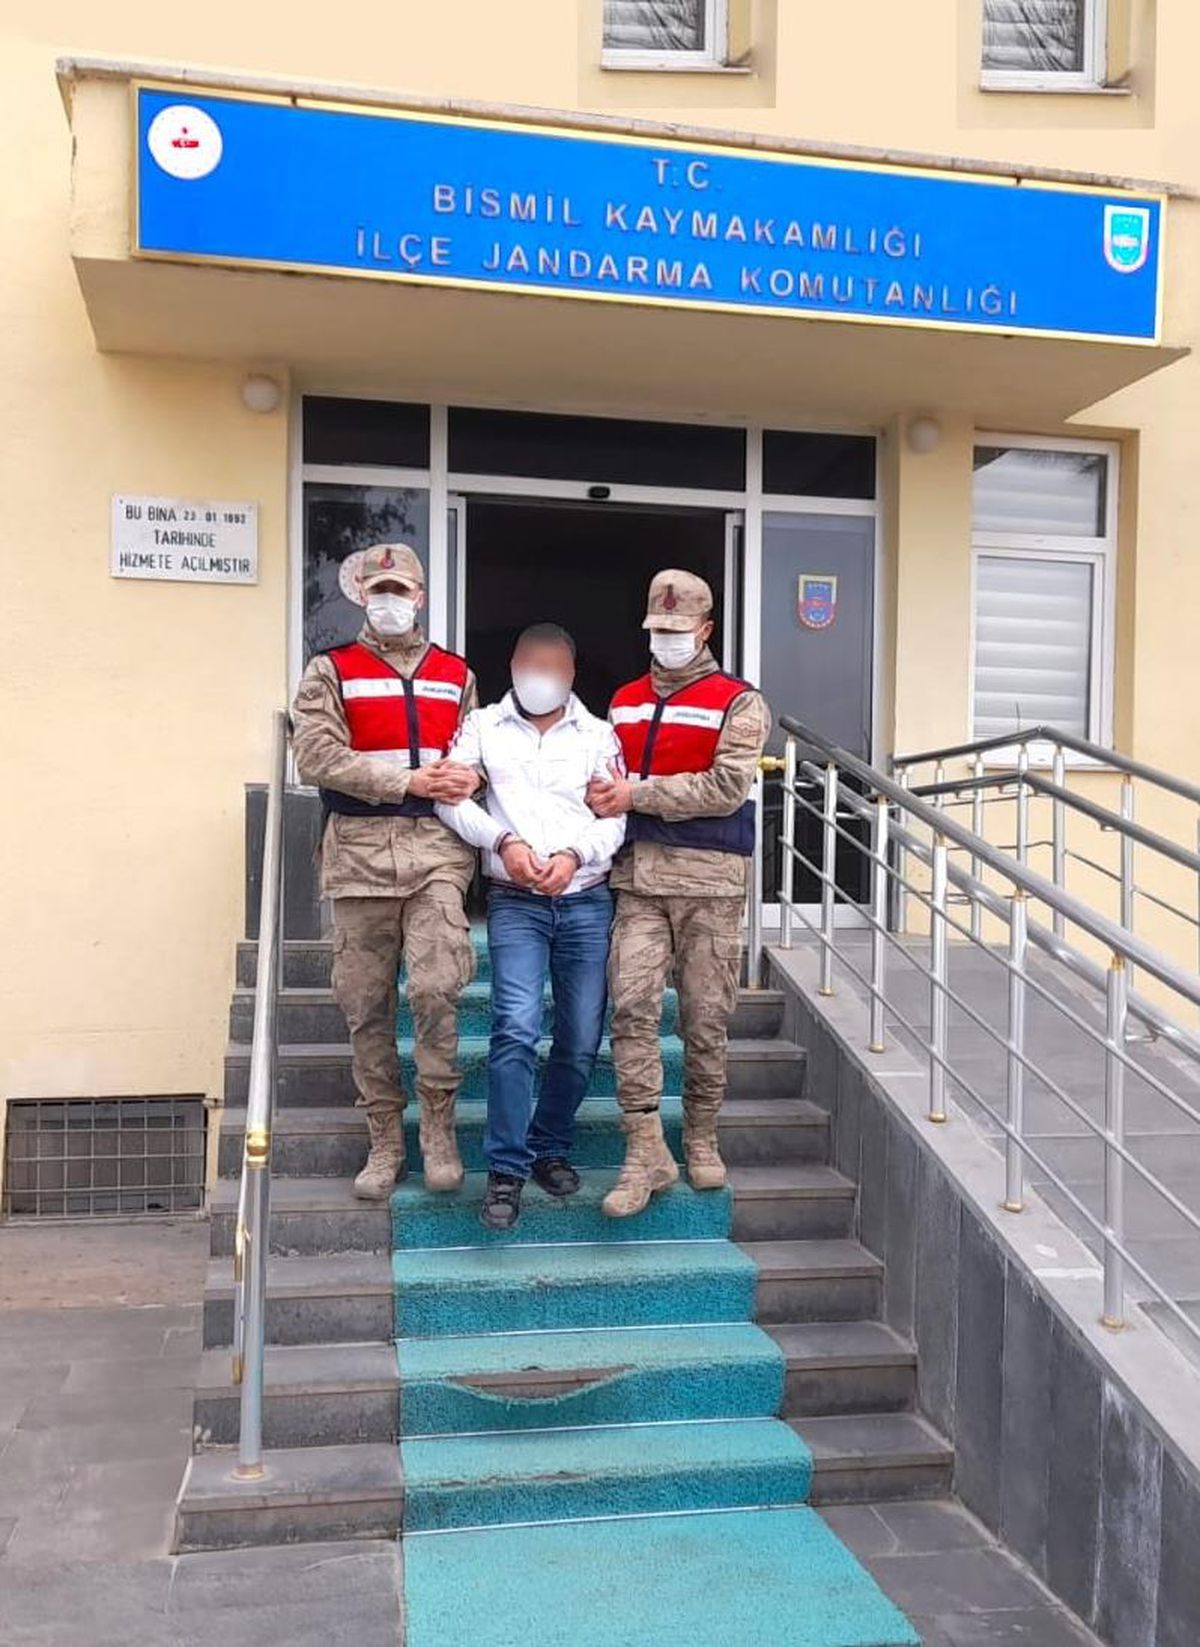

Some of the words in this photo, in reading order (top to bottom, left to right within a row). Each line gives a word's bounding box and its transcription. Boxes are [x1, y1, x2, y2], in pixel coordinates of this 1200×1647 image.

[433, 183, 582, 226] BİSMİL
[606, 202, 922, 258] KAYMAKAMLIĞI
[356, 224, 452, 269] İLÇE
[483, 241, 713, 290] JANDARMA
[740, 265, 1018, 316] KOMUTANLIĞI
[126, 505, 142, 520] BU
